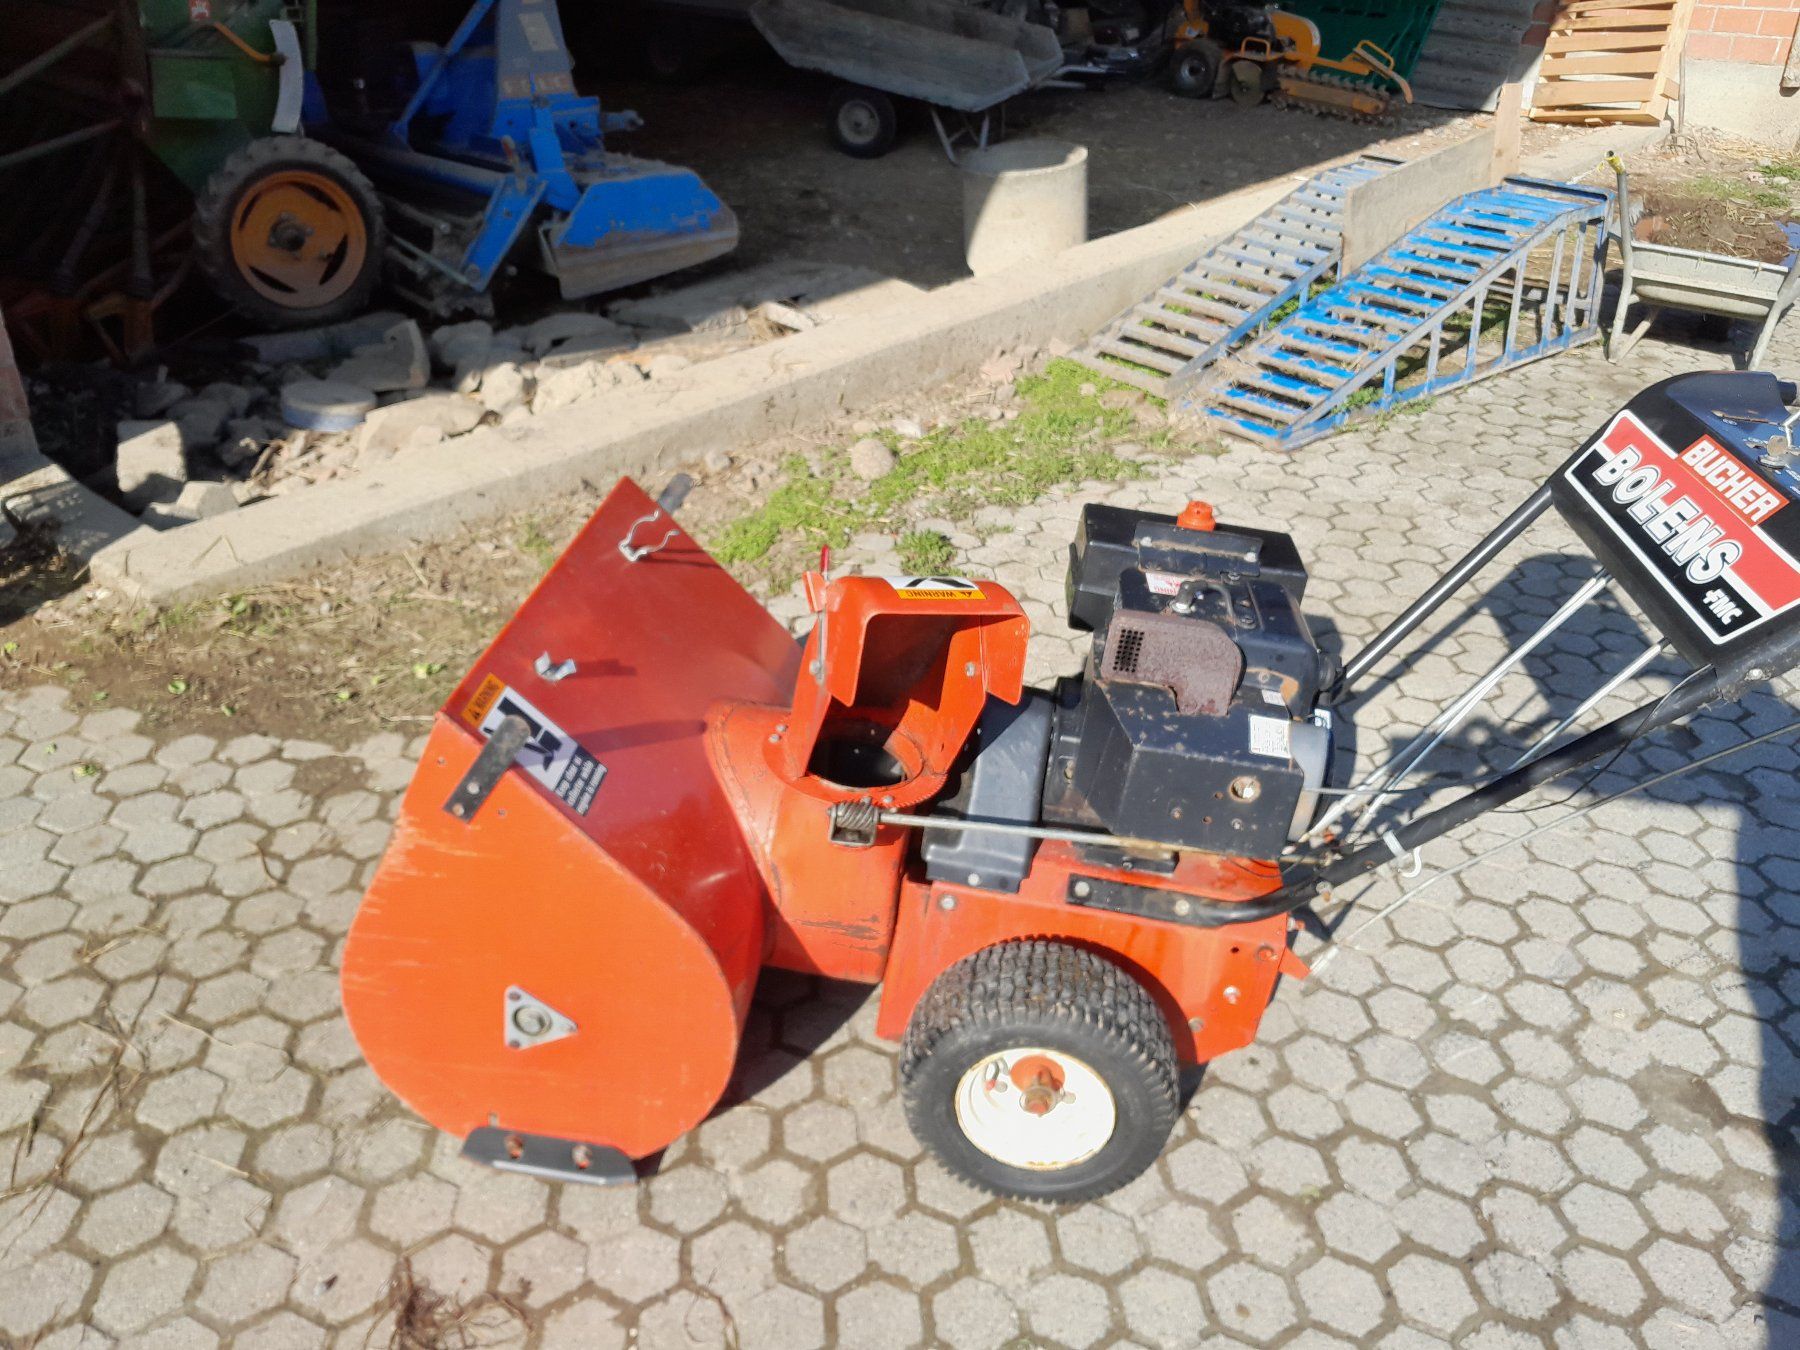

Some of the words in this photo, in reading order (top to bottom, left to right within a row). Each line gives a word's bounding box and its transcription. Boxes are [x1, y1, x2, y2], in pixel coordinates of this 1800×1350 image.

[1592, 446, 1743, 585] BOLENS
[1681, 439, 1780, 522] BUCHER
[1703, 589, 1743, 626] FMC
